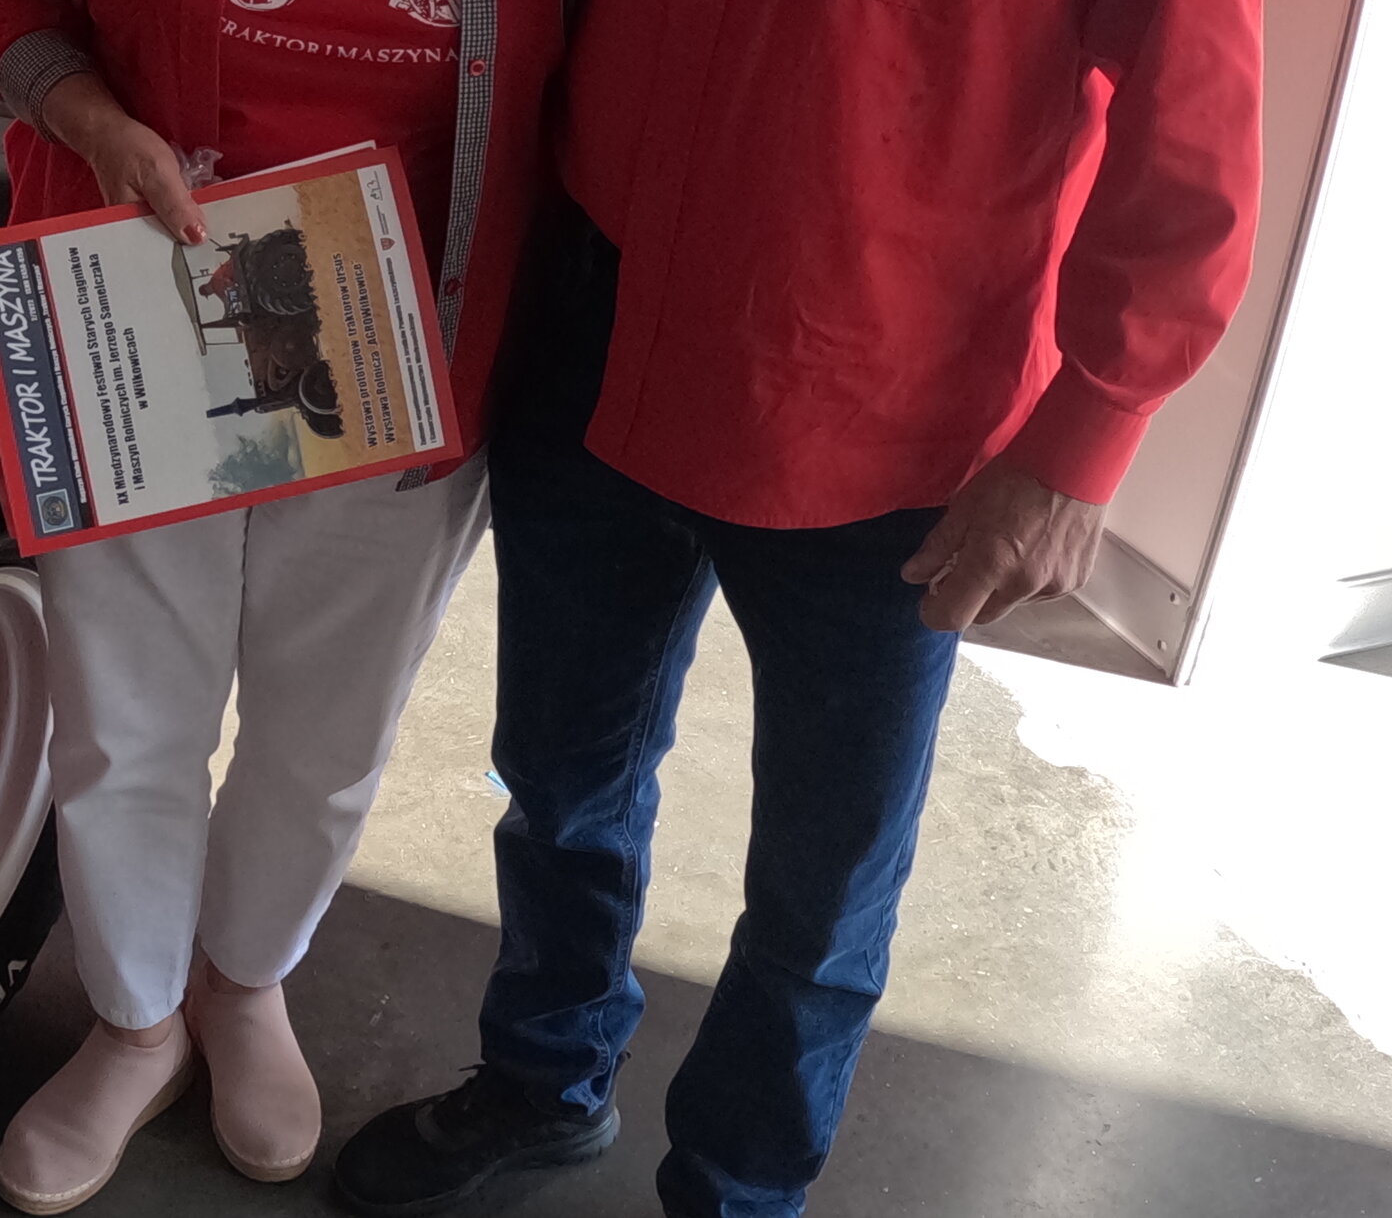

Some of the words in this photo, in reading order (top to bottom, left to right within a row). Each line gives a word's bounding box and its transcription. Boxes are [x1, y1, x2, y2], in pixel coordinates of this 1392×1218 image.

[337, 45, 460, 64] MASZYNA
[68, 246, 89, 305] Ciągników
[88, 252, 112, 320] Samelczaka
[331, 252, 347, 284] Ursus
[79, 305, 99, 350] Starych
[103, 320, 120, 363] Jerzego
[88, 350, 108, 397] Festiwal
[112, 363, 124, 382] im.
[122, 326, 146, 399] Wilkowicach
[370, 349, 387, 395] Rolnicza
[114, 382, 136, 443] Rolniczych
[137, 399, 148, 410] w
[361, 399, 378, 448] Wystawa
[378, 395, 396, 444] Wystawa
[15, 381, 57, 487] TRAKTOR
[99, 397, 126, 490] Międzynarodowy
[127, 442, 144, 485] Maszyn
[115, 490, 129, 505] XX
